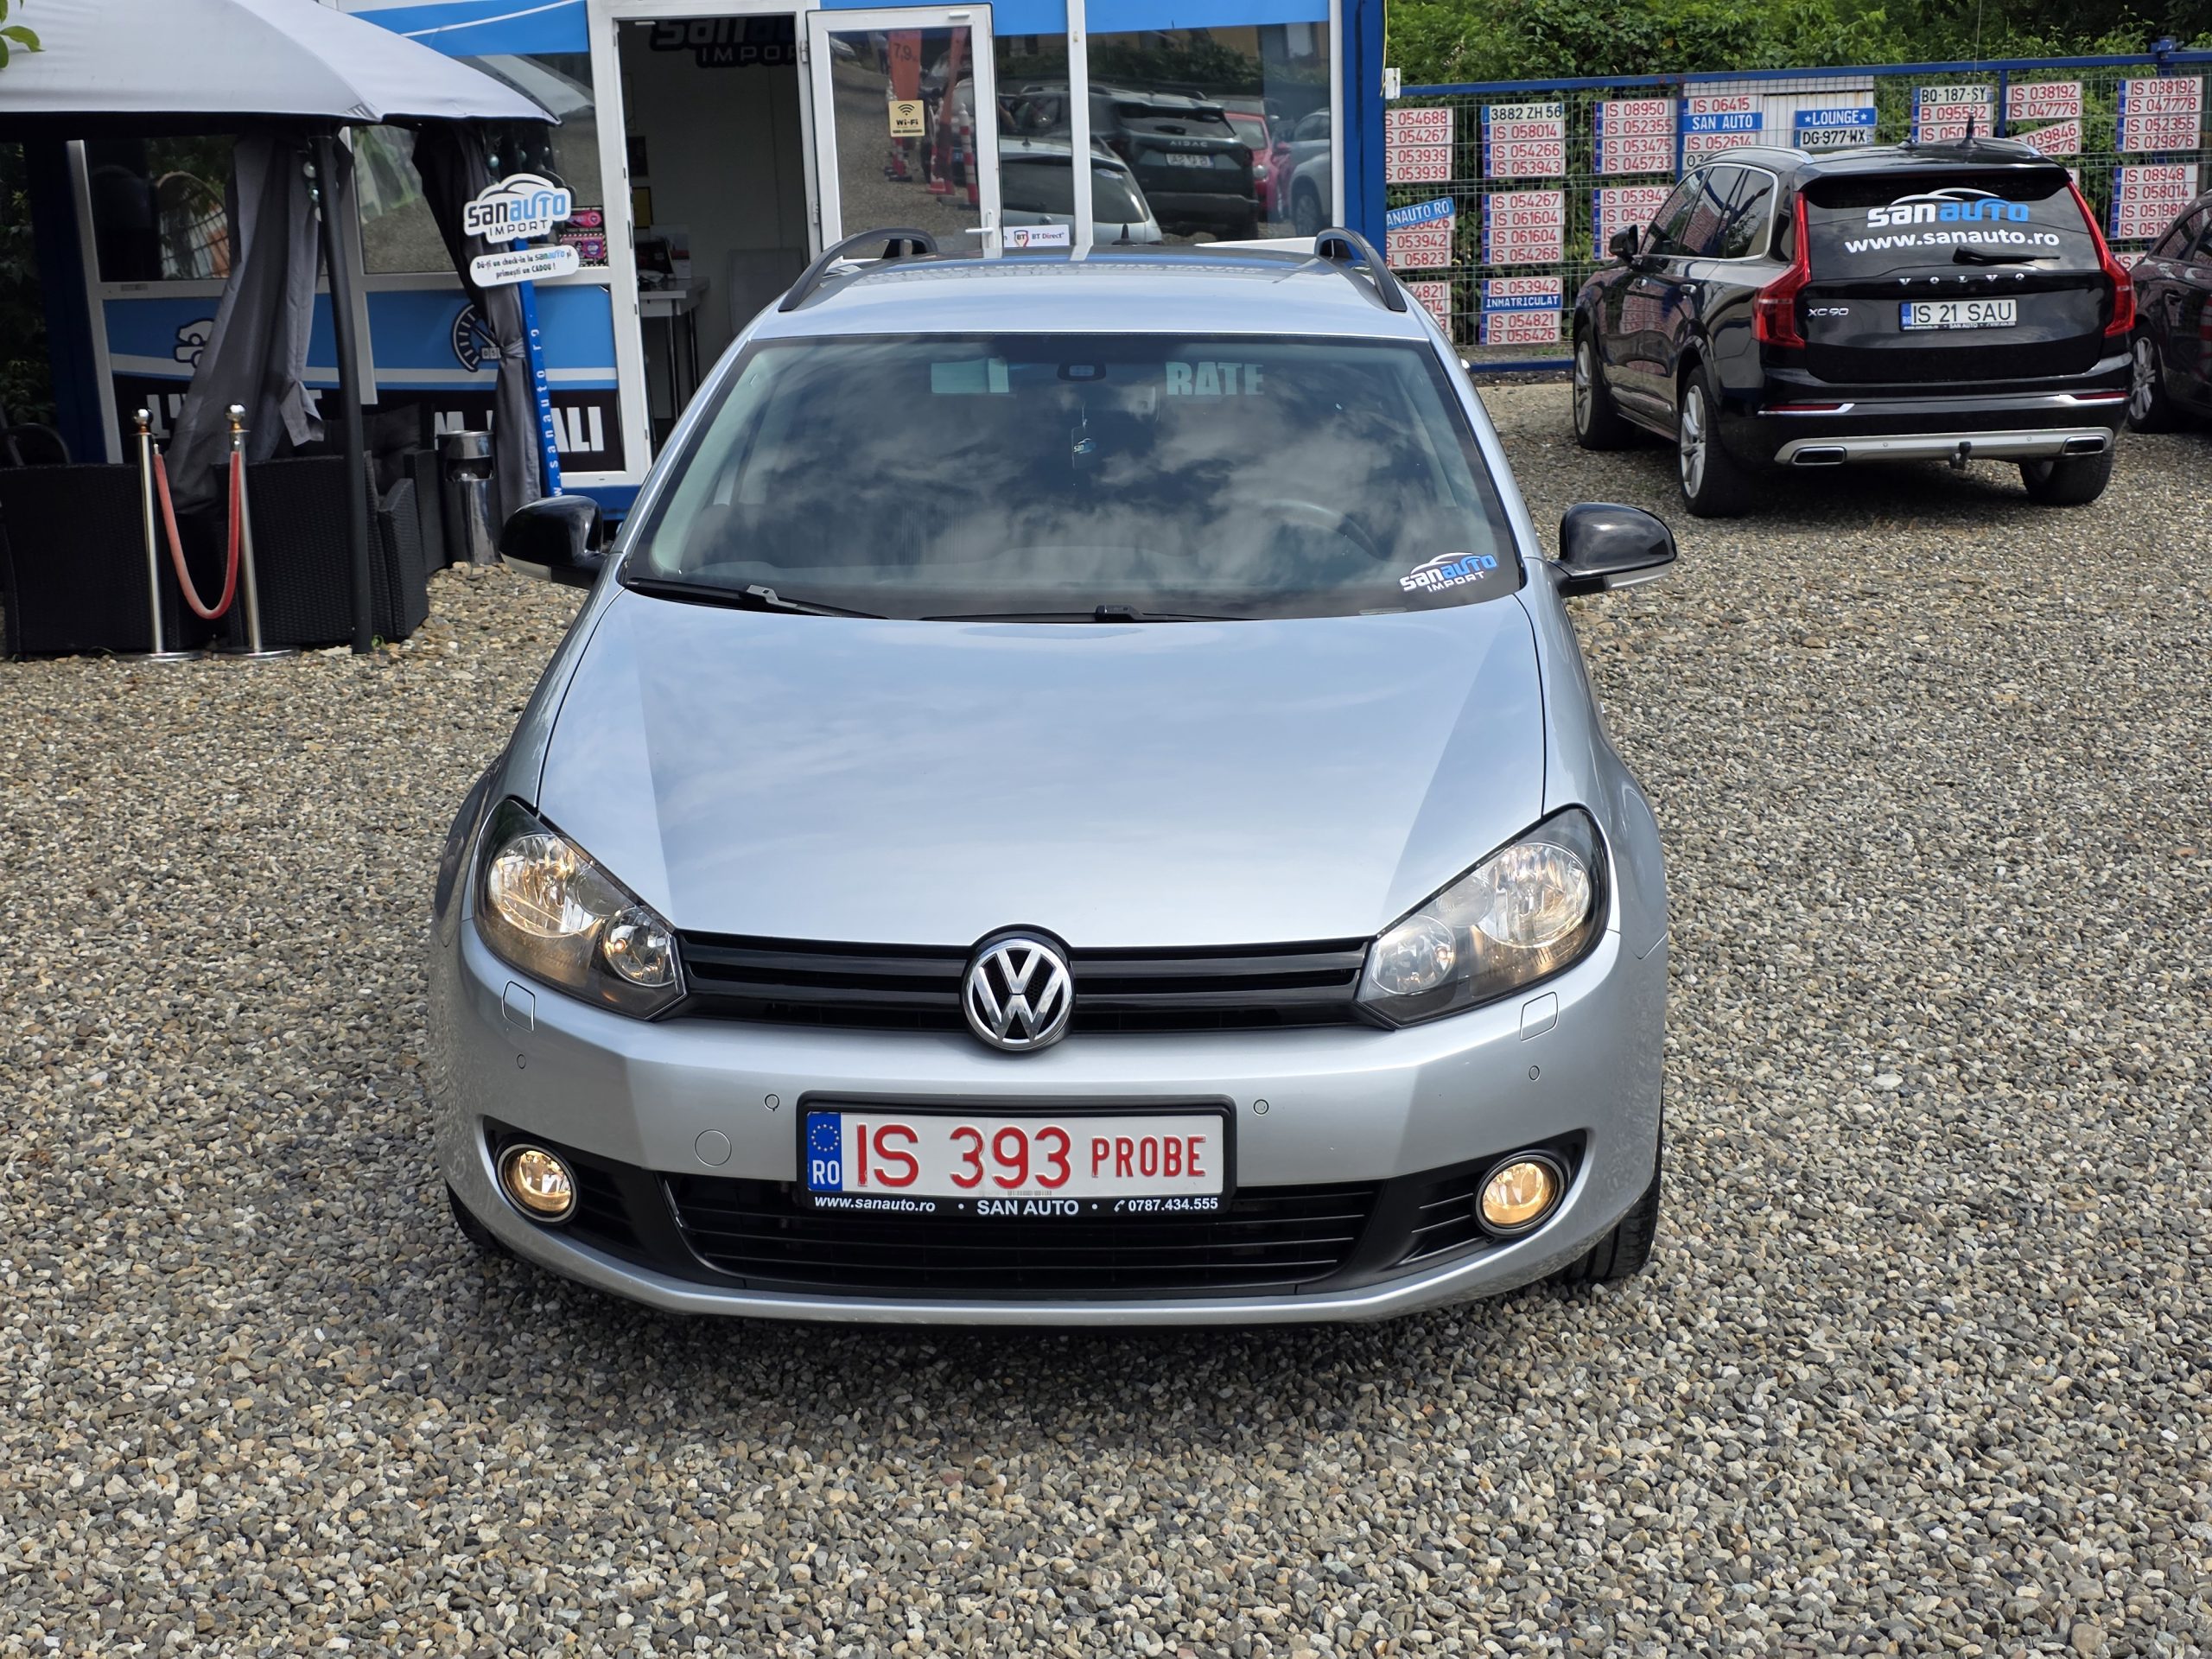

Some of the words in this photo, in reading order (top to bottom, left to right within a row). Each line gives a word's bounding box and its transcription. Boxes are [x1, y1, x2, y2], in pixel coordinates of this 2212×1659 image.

[2012, 87, 2024, 101] IS
[2030, 85, 2076, 100] 038192
[2131, 82, 2144, 95] IS
[2149, 79, 2196, 94] 038192
[1491, 107, 1523, 120] 3882
[1527, 106, 1542, 119] ZH
[1546, 105, 1562, 118] 56
[1605, 104, 1618, 118] IS
[1624, 102, 1665, 116] 08950
[1694, 99, 1707, 113] IS
[1712, 97, 1750, 112] 06415
[2009, 104, 2023, 118] IS
[2028, 102, 2078, 117] 047778
[2127, 99, 2141, 113] IS
[2146, 97, 2196, 111] 047778
[1386, 113, 1393, 126] S
[1398, 111, 1447, 125] 054688
[1693, 116, 1716, 130] SAN
[1722, 114, 1753, 129] AUTO
[1812, 110, 1859, 125] LOUNGE
[1921, 107, 1931, 121] B
[1493, 126, 1506, 139] IS
[1511, 124, 1556, 138] 058014
[1605, 121, 1618, 135] IS
[1624, 118, 1673, 134] 052355
[2126, 119, 2140, 132] IS
[2145, 117, 2195, 131] 052355
[1386, 130, 1394, 144] S
[1399, 129, 1447, 143] 054267
[1921, 127, 1935, 142] IS
[1940, 125, 1988, 138] 05005
[2027, 123, 2076, 147] 039846
[2126, 137, 2139, 149] IS
[2144, 134, 2194, 149] 029876
[1492, 145, 1505, 159] IS
[1510, 143, 1560, 157] 054266
[1605, 141, 1618, 154] IS
[1623, 138, 1672, 153] 053475
[1687, 137, 1700, 150] IS
[1386, 150, 1393, 163] S
[1398, 149, 1447, 163] 053939
[1605, 157, 1618, 171] IS
[1623, 156, 1672, 170] 045733
[1386, 168, 1392, 181] S
[1397, 166, 1446, 180] 053939
[1493, 162, 1506, 175] IS
[1511, 161, 1560, 175] 053943
[2125, 169, 2138, 183] IS
[2143, 168, 2184, 181] 08948
[1603, 191, 1616, 204] IS
[2124, 187, 2138, 200] IS
[2142, 184, 2189, 199] 058014
[1491, 196, 1505, 209] IS
[1510, 193, 1559, 208] 054267
[1386, 205, 1431, 226] ANAUTO
[1433, 200, 1450, 214] RO
[1494, 213, 1507, 226] IS
[1512, 211, 1558, 226] 061604
[1604, 209, 1616, 222] IS
[1621, 207, 1660, 221] 0542
[2121, 205, 2135, 219] IS
[489, 219, 548, 236] IMPORT
[2120, 223, 2134, 236] IS
[2139, 221, 2168, 235] 0519
[1387, 236, 1392, 249] S
[1397, 234, 1446, 248] 053942
[1493, 231, 1506, 245] IS
[1511, 229, 1556, 244] 061604
[1844, 229, 2060, 253] www.sanauto.ro
[1405, 251, 1446, 266] 05823
[1491, 250, 1504, 263] IS
[1510, 247, 1559, 262] 054266
[1491, 282, 1503, 295] IS
[1509, 279, 1558, 294] 053942
[1486, 296, 1559, 308] INMATRICULAT
[1491, 315, 1503, 328] IS
[1509, 313, 1554, 327] 054821
[1913, 305, 1931, 323] IS
[1939, 304, 1957, 322] 21
[1967, 302, 2012, 321] SAU
[1489, 330, 1502, 343] IS
[1507, 328, 1555, 342] 056426
[1166, 361, 1264, 396] RATE
[1427, 571, 1484, 593] IMPORT
[857, 1122, 919, 1187] IS
[950, 1124, 1071, 1189] 393
[1091, 1135, 1206, 1179] PROBE
[812, 1160, 840, 1185] RO
[814, 1196, 936, 1212] www.sanauto.ro
[977, 1199, 1018, 1215] SAN
[1023, 1199, 1079, 1215] AUTO
[1128, 1198, 1218, 1211] 0787.434.555
